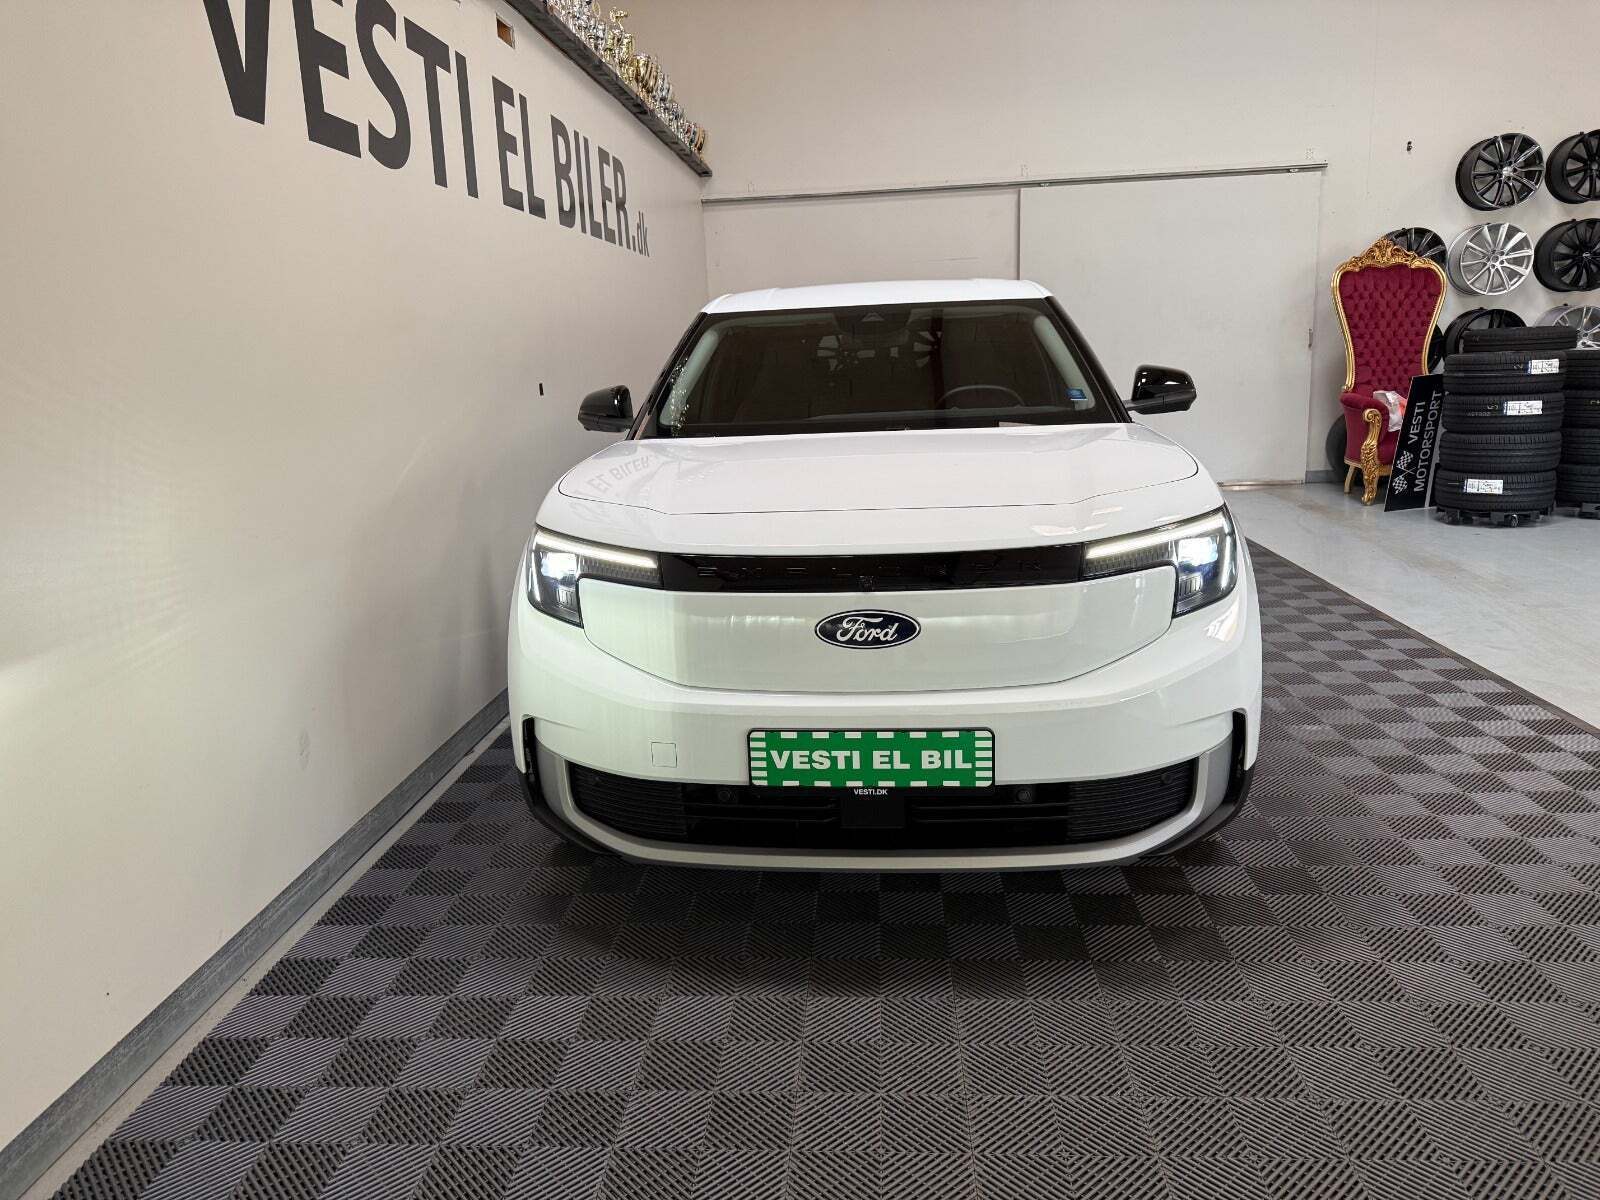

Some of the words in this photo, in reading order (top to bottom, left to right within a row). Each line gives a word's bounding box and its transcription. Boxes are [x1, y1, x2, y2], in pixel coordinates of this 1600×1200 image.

[204, 0, 479, 199] VESTI
[491, 76, 546, 219] EL
[1407, 401, 1426, 445] VESTI
[1413, 390, 1442, 492] MOTORSPORT
[836, 616, 898, 642] Ford
[770, 750, 861, 769] VESTI
[872, 750, 910, 769] EL
[921, 750, 972, 769] BIL
[853, 788, 888, 796] VESTI.DK
